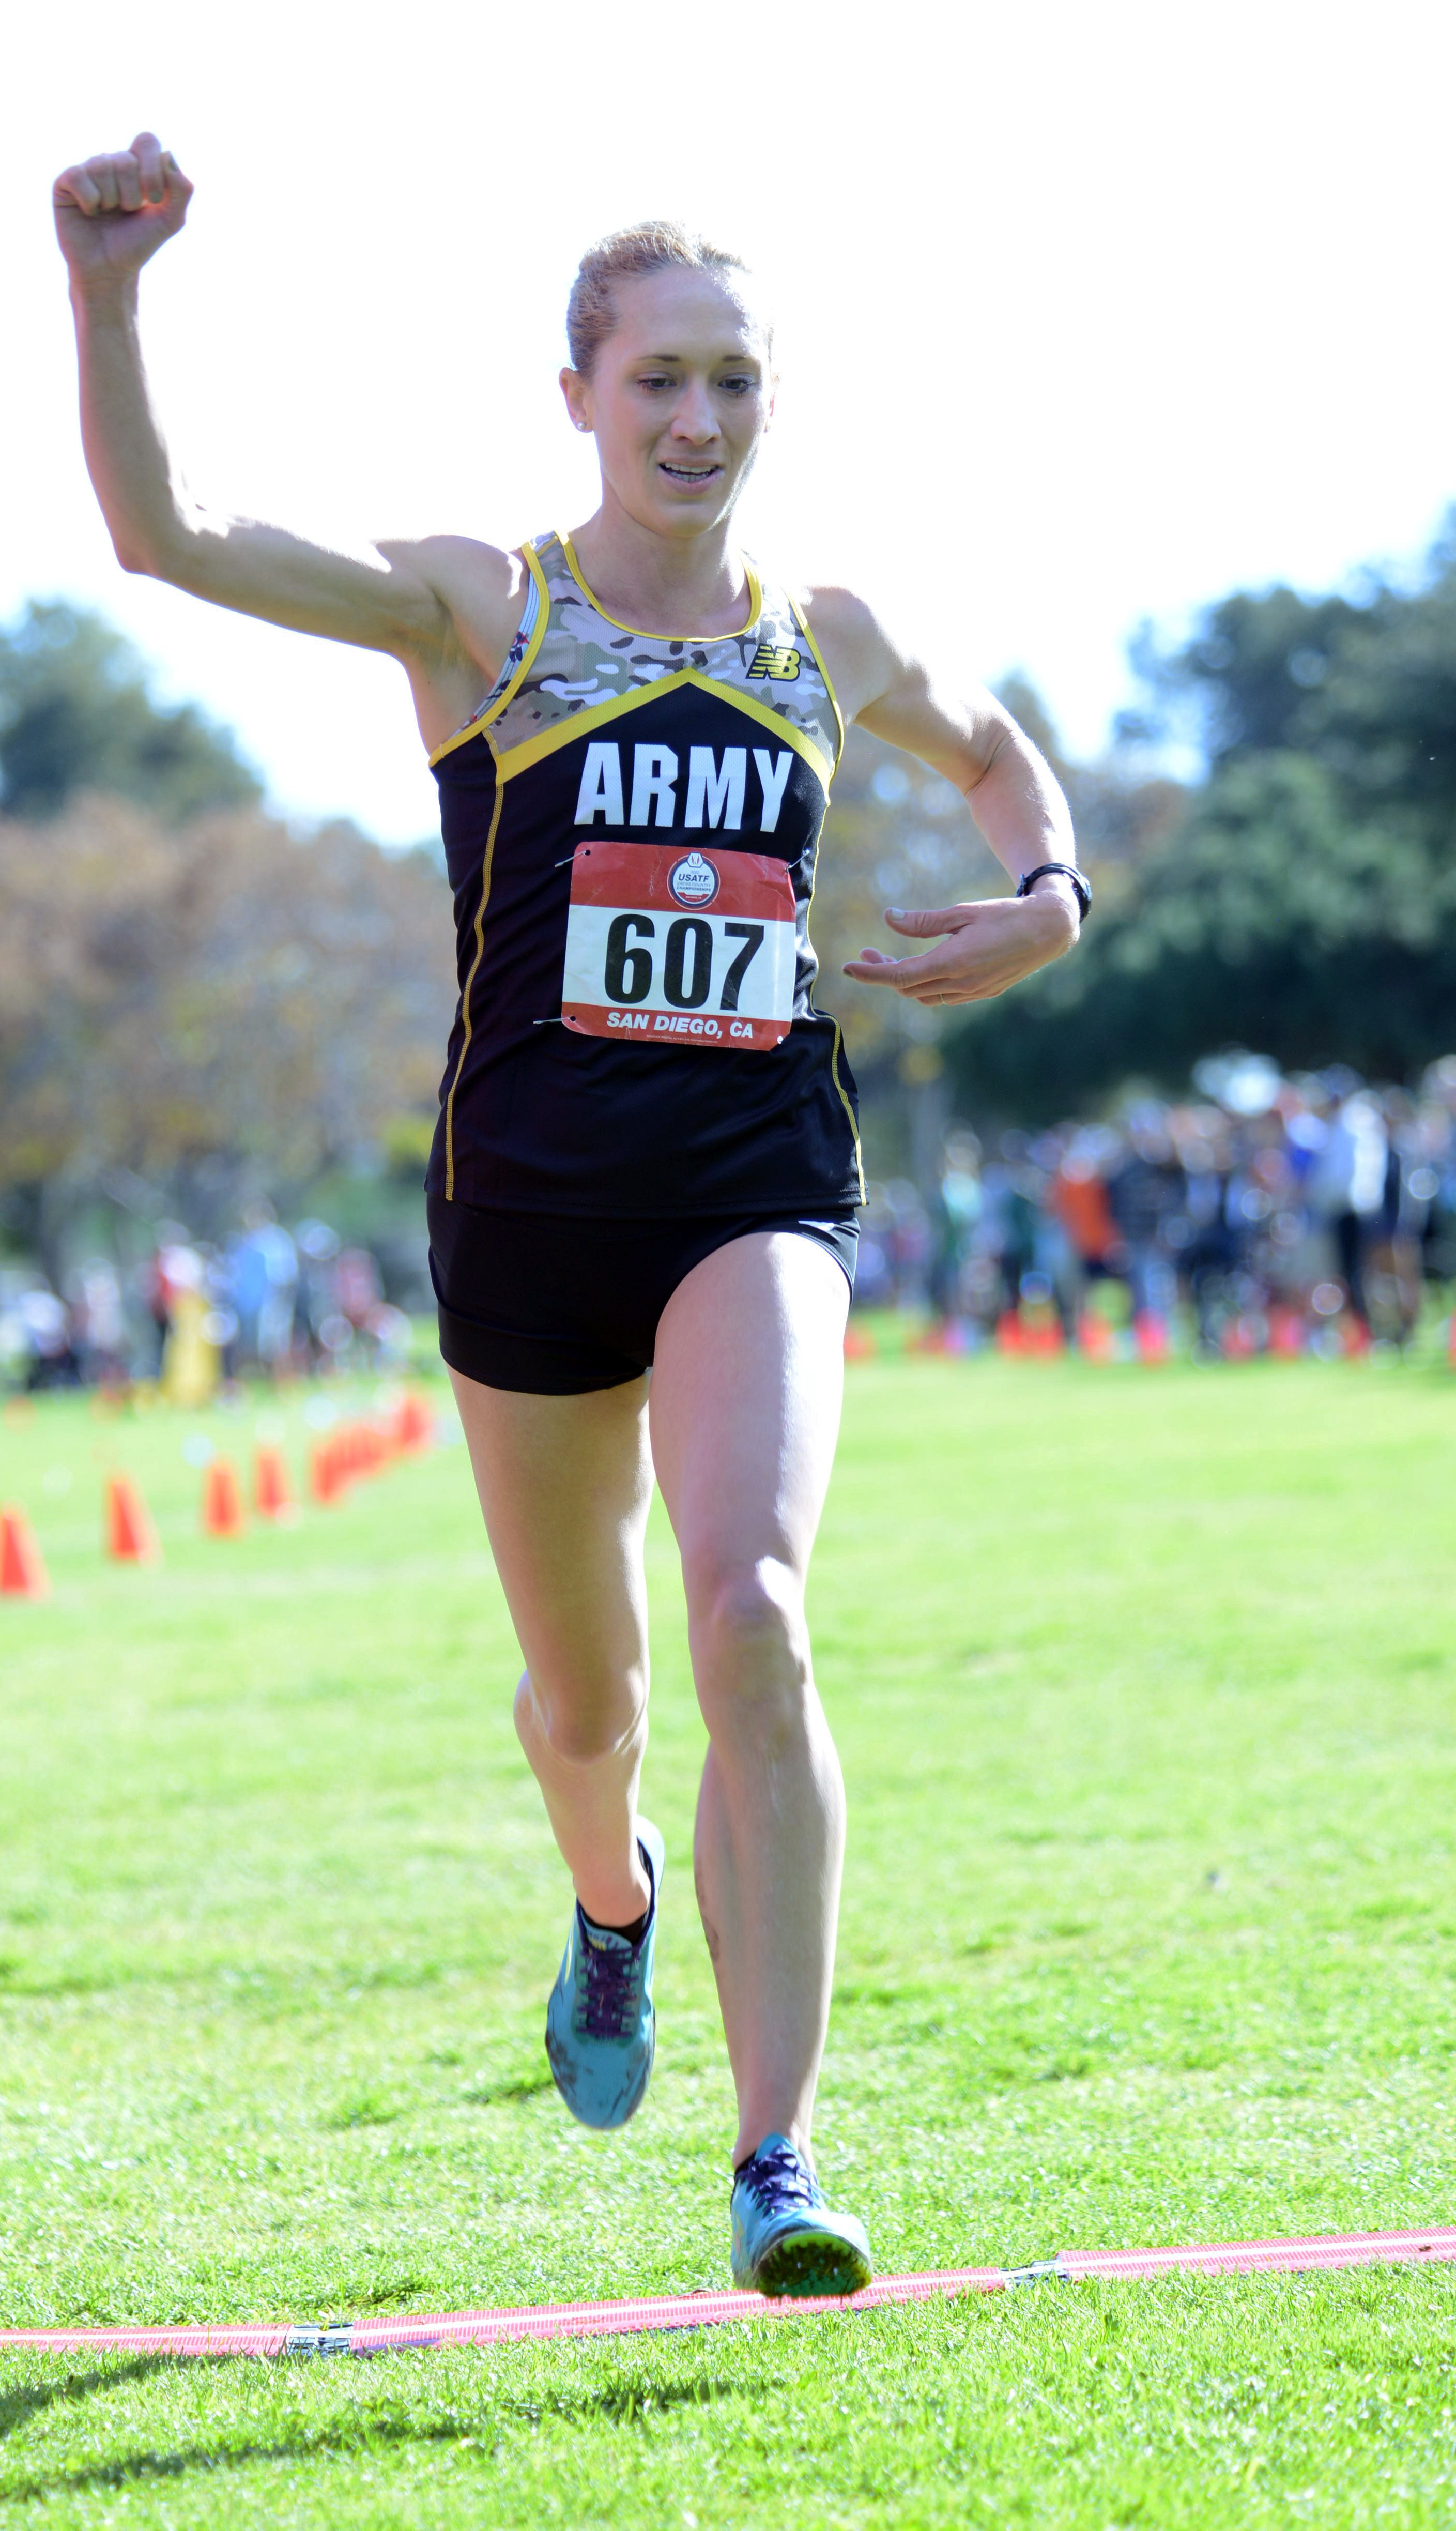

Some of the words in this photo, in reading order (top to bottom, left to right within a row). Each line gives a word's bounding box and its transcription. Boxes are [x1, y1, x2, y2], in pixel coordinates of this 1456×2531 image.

[745, 643, 801, 682] NB
[574, 742, 794, 833] ARMY
[678, 874, 710, 882] USATF
[604, 913, 764, 1011] 607
[606, 1012, 650, 1030] SAN
[653, 1015, 723, 1039] DIEGO,
[729, 1021, 753, 1039] CA
